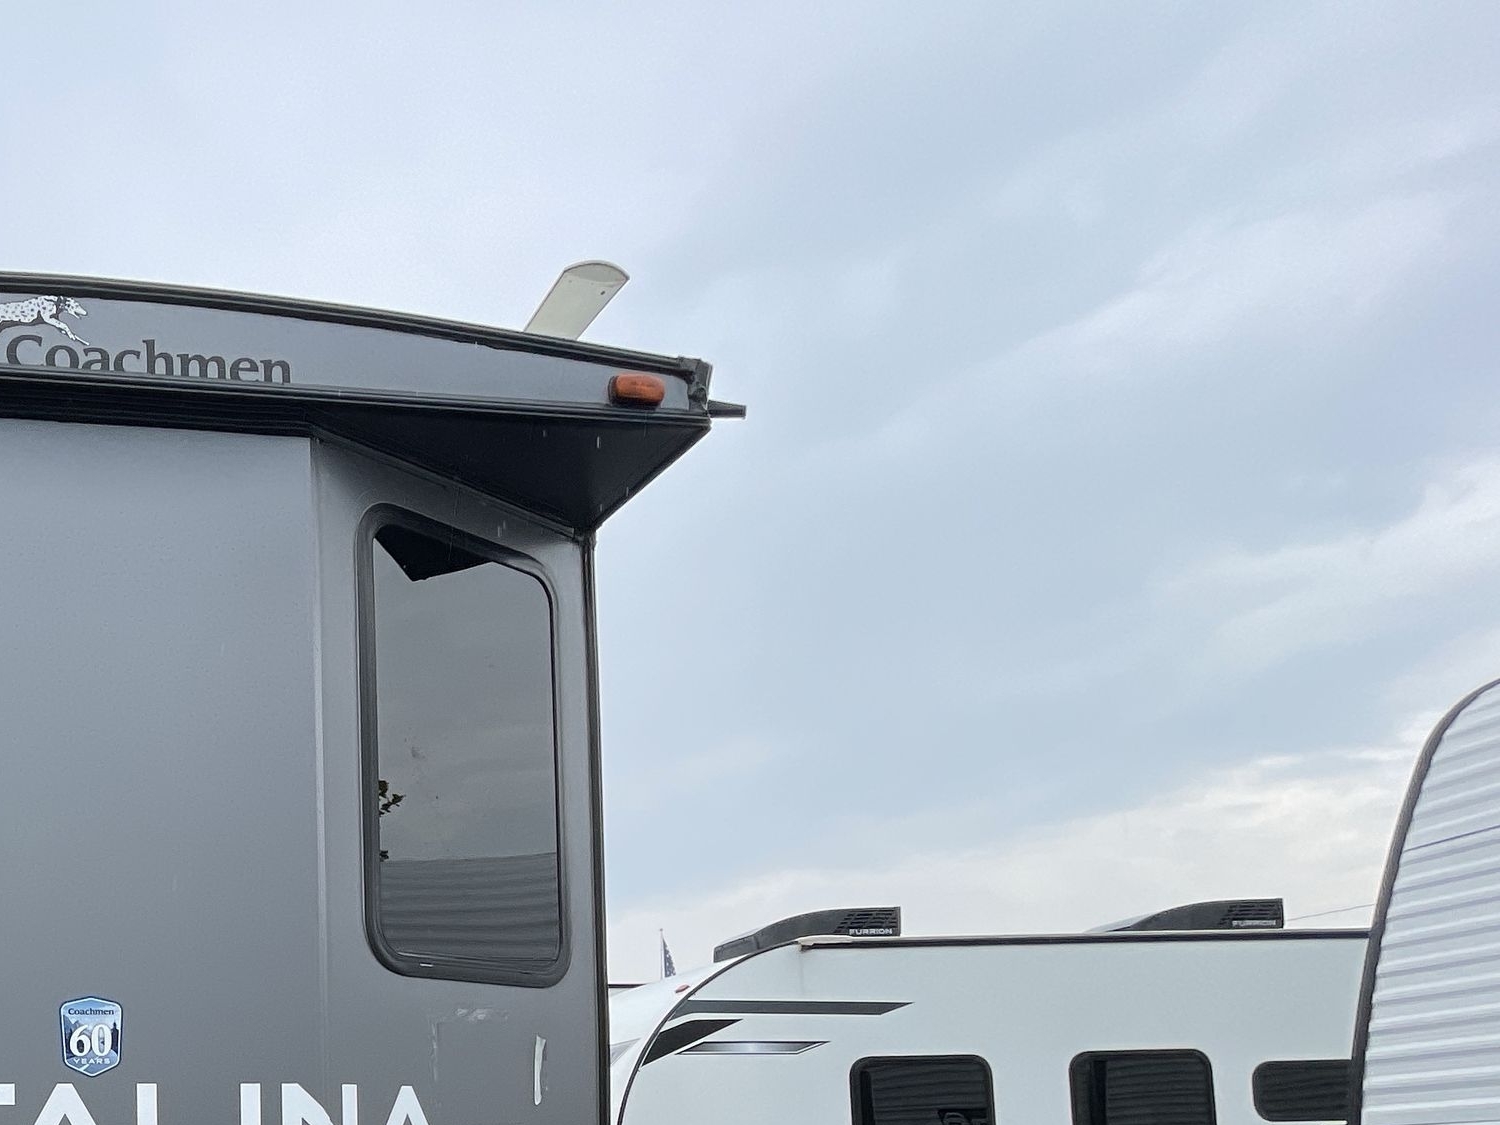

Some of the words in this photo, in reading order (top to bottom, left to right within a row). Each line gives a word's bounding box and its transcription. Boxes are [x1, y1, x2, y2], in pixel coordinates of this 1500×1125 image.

[6, 333, 292, 385] Coachmen
[849, 928, 893, 936] FURRION
[69, 1024, 112, 1057] 60
